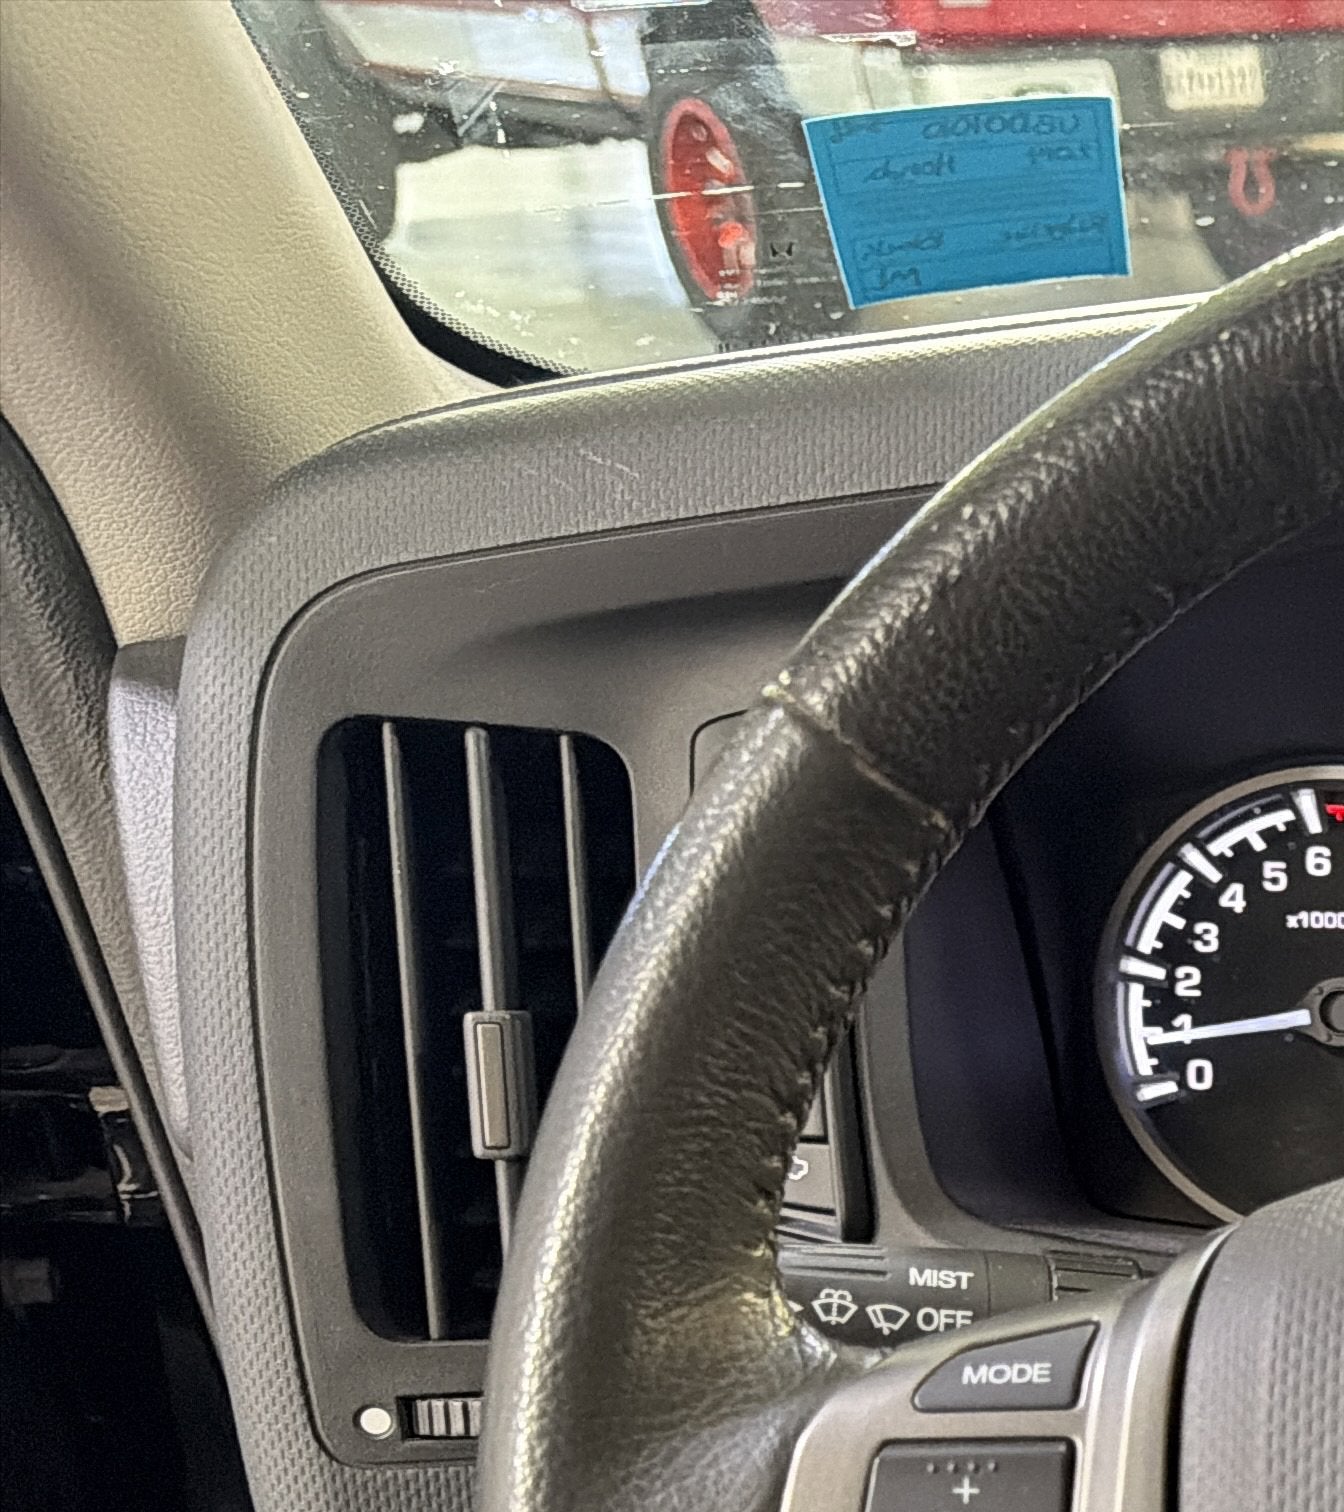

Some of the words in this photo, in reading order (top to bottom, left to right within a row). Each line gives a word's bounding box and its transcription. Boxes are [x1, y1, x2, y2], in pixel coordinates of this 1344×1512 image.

[1262, 860, 1288, 892] 5
[1305, 845, 1332, 877] 6
[1218, 882, 1247, 914] 4
[1193, 921, 1219, 953] 3
[1174, 965, 1202, 997] 2
[1186, 1058, 1214, 1091] 0
[908, 1266, 975, 1290] MIST
[916, 1306, 974, 1332] OFF
[962, 1362, 1052, 1385] MODE
